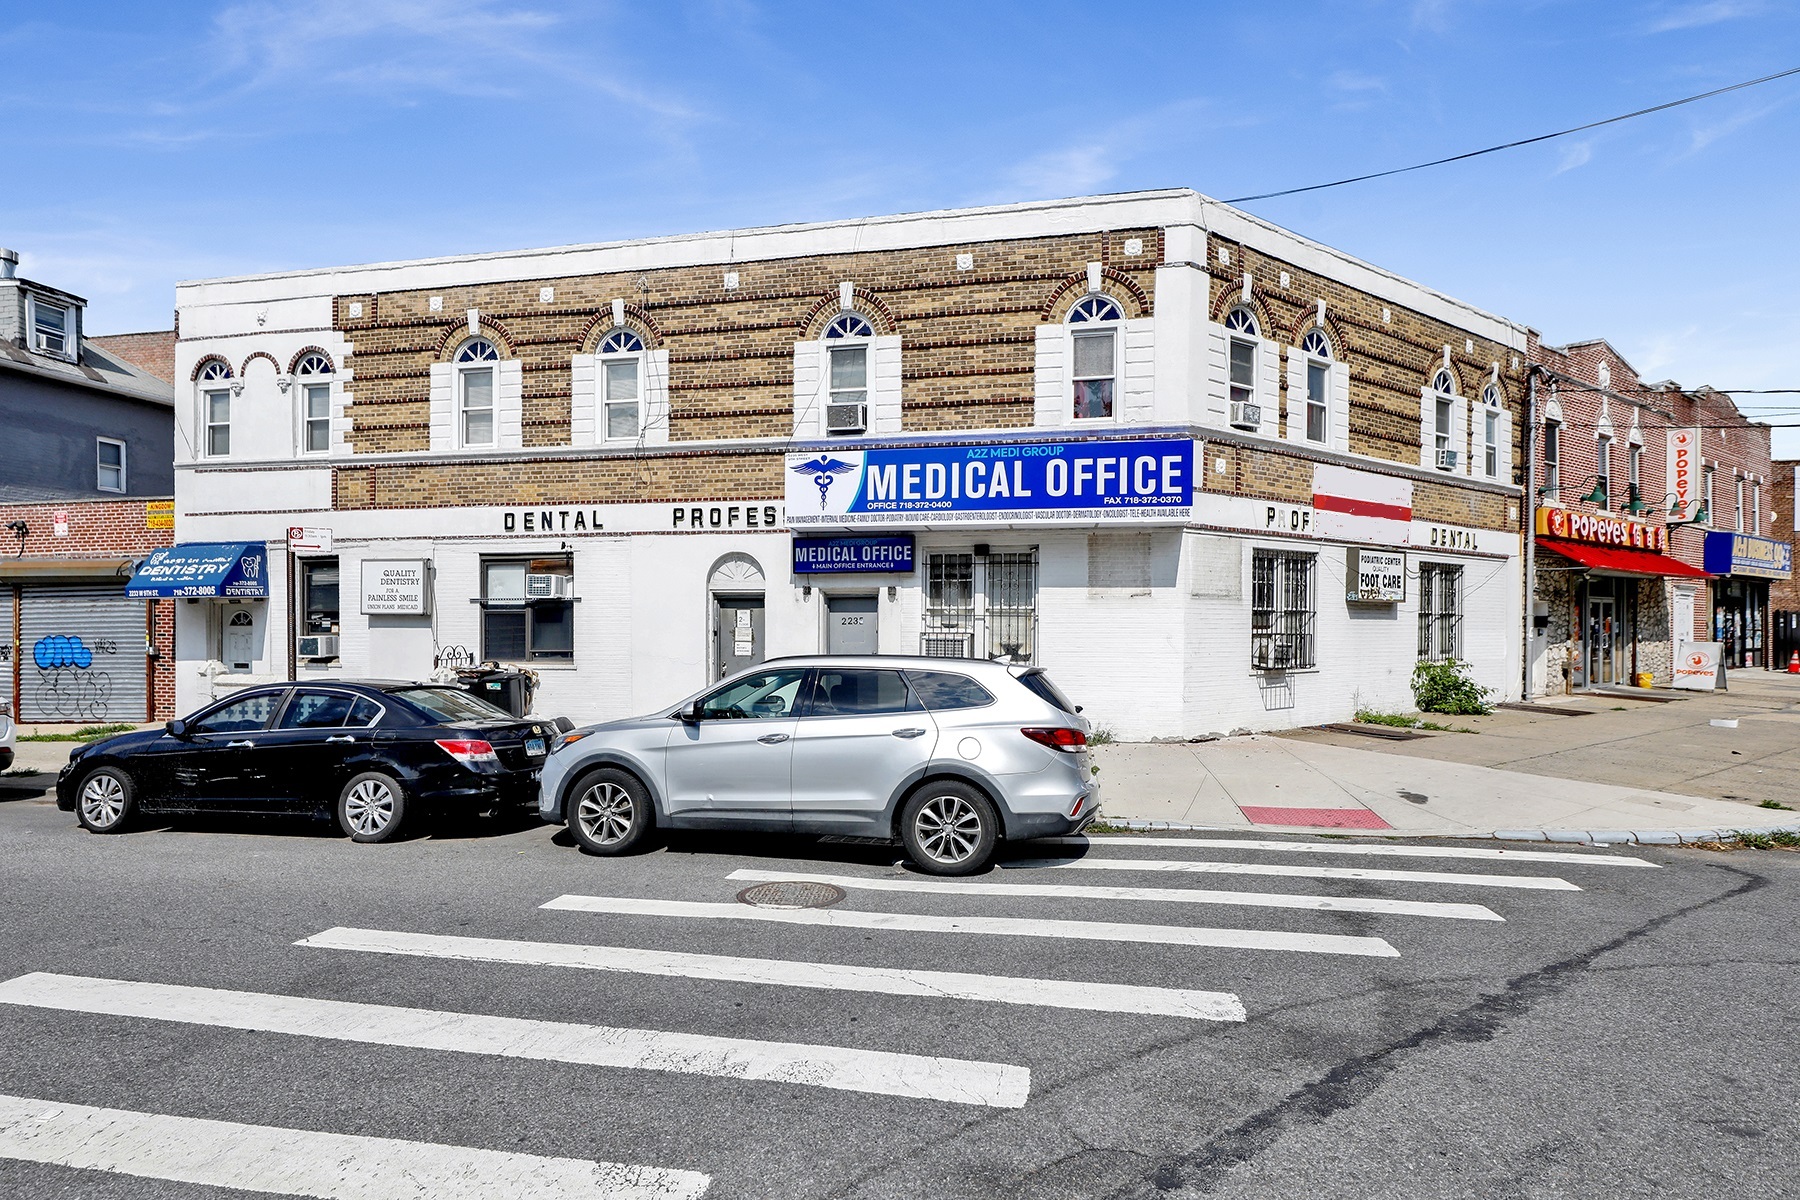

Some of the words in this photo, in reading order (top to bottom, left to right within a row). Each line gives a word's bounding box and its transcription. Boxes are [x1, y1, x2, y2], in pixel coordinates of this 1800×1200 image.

[967, 448, 988, 459] A2Z
[991, 447, 1019, 458] MEDI
[1022, 446, 1064, 457] GROUP
[867, 460, 1032, 501] MEDICAL
[1046, 455, 1182, 497] OFFICE
[1104, 496, 1122, 505] FAX
[1124, 495, 1182, 504] 718-372-0370
[867, 502, 897, 510] OFFICE
[899, 501, 952, 509] 718-372-0400
[1179, 508, 1190, 517] HERE
[504, 510, 603, 532] DENTAL
[672, 506, 785, 528] PROFES
[1570, 513, 1628, 544] POPEYES
[1429, 527, 1478, 550] DENTAL
[795, 546, 857, 562] MEDICAL
[862, 545, 912, 561] OFFICE
[1361, 555, 1383, 565] PODIATRIC
[1384, 556, 1401, 566] CENTER
[139, 563, 230, 576] DENTISTRY
[383, 569, 416, 577] QUALITY
[1372, 565, 1389, 573] QUALITY
[380, 578, 420, 586] DENTISTRY
[1360, 573, 1379, 588] FOOT
[1382, 574, 1401, 589] CARE
[173, 586, 216, 596] 718-372-8005
[398, 594, 418, 602] SMILE
[1676, 668, 1714, 677] POPEYES
